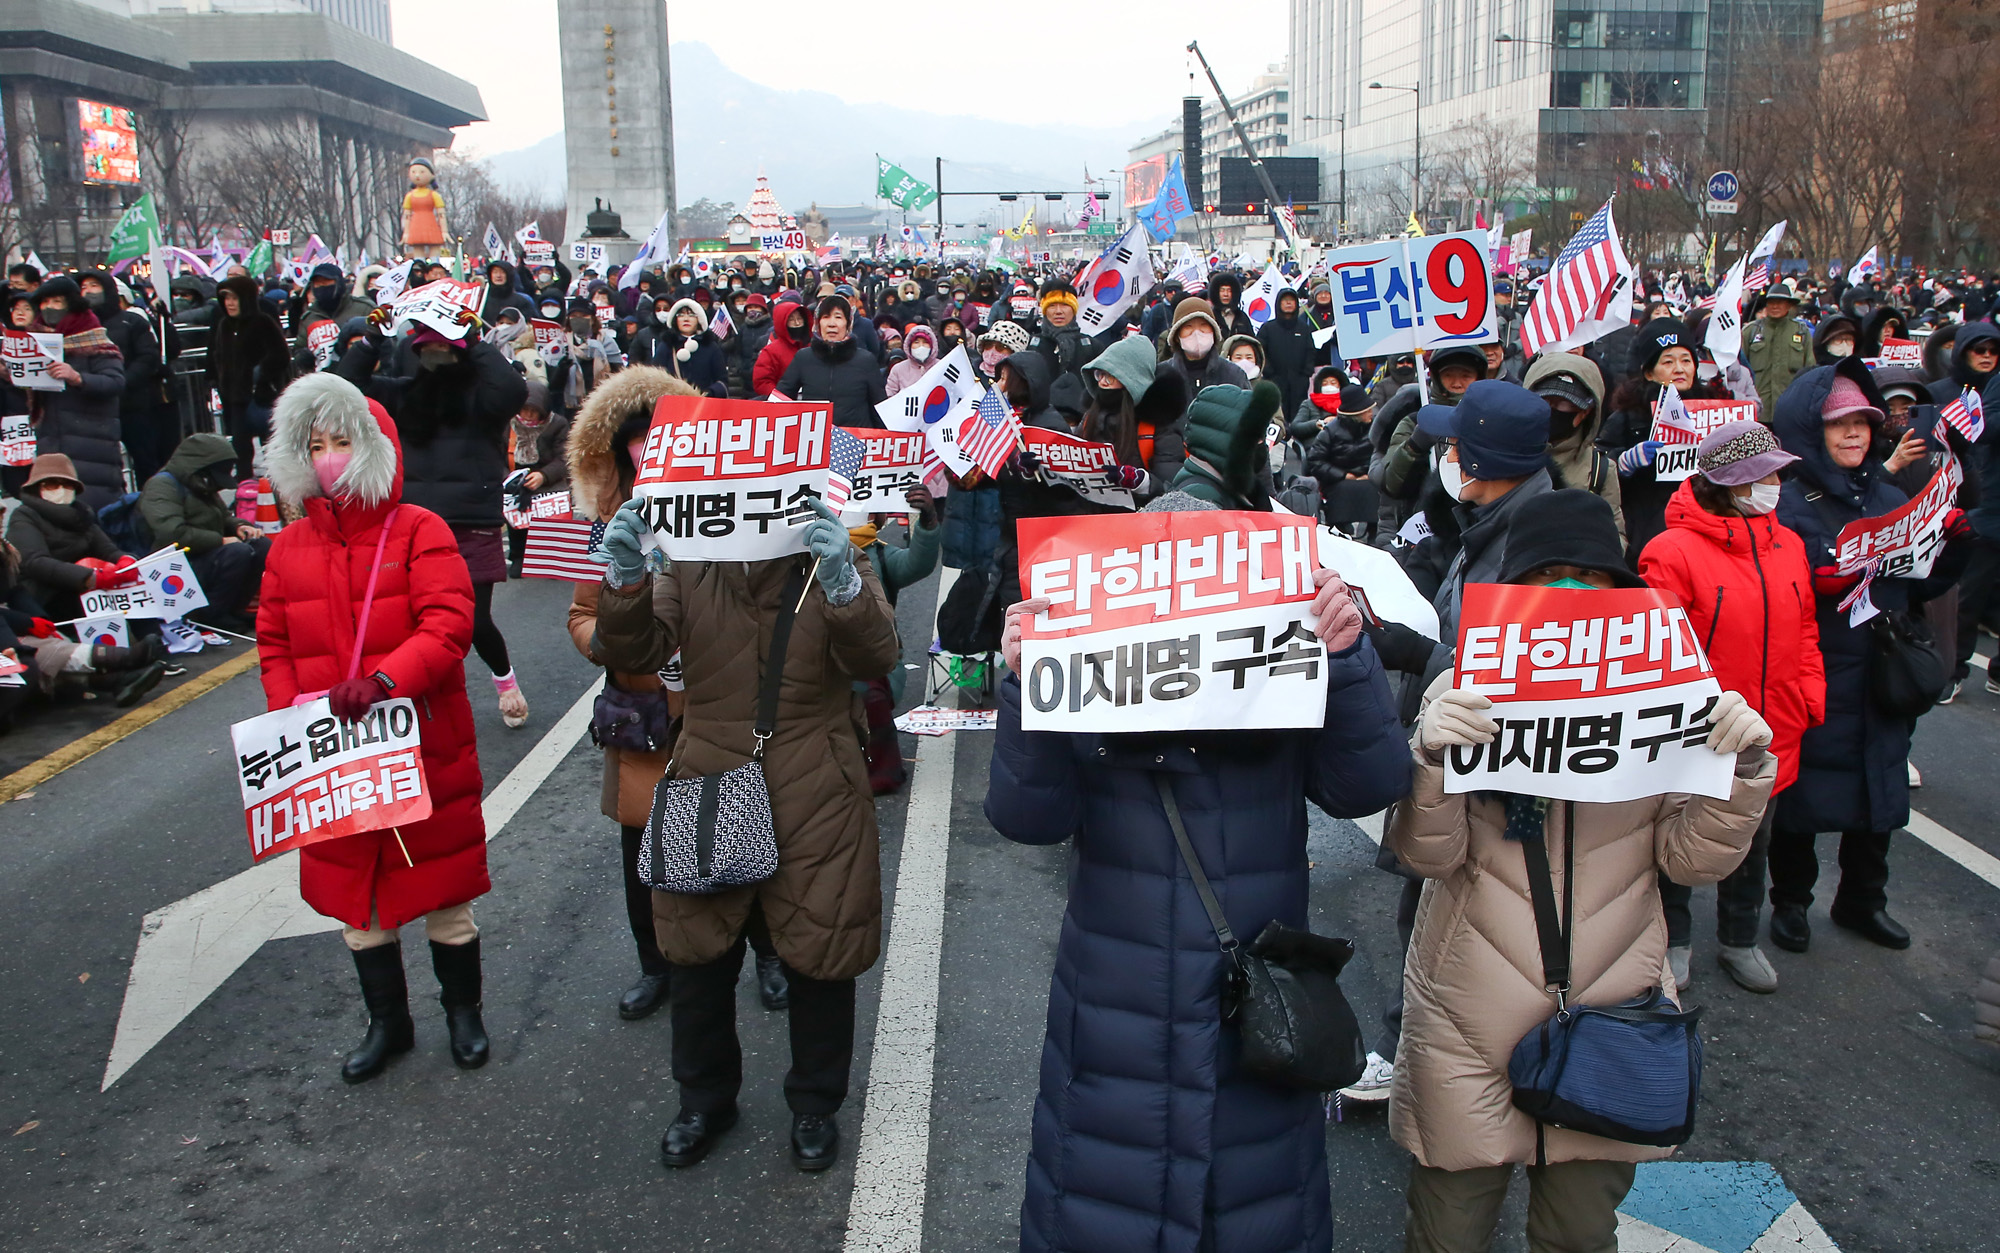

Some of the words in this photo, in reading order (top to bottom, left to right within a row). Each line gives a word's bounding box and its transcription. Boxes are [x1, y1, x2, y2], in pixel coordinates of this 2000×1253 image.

[763, 236, 784, 249] 부산
[785, 232, 804, 249] 49
[1341, 261, 1424, 334] 부산
[1426, 237, 1488, 335] 9
[639, 410, 828, 480] 탄핵반대
[860, 435, 923, 467] 반대
[1666, 405, 1754, 441] 핵반대
[1029, 443, 1117, 471] 탄핵반대
[1657, 447, 1699, 474] 이재
[1839, 471, 1950, 570] 탄핵반대
[87, 594, 131, 613] 이재명
[132, 590, 155, 608] 구
[1030, 526, 1315, 633] 탄핵반대
[1029, 633, 1200, 714] 이재명
[1212, 620, 1322, 691] 구속
[1460, 606, 1713, 695] 탄핵반대
[240, 734, 302, 791] 구속
[306, 705, 413, 763] 이재명
[252, 752, 422, 856] 탄핵반대
